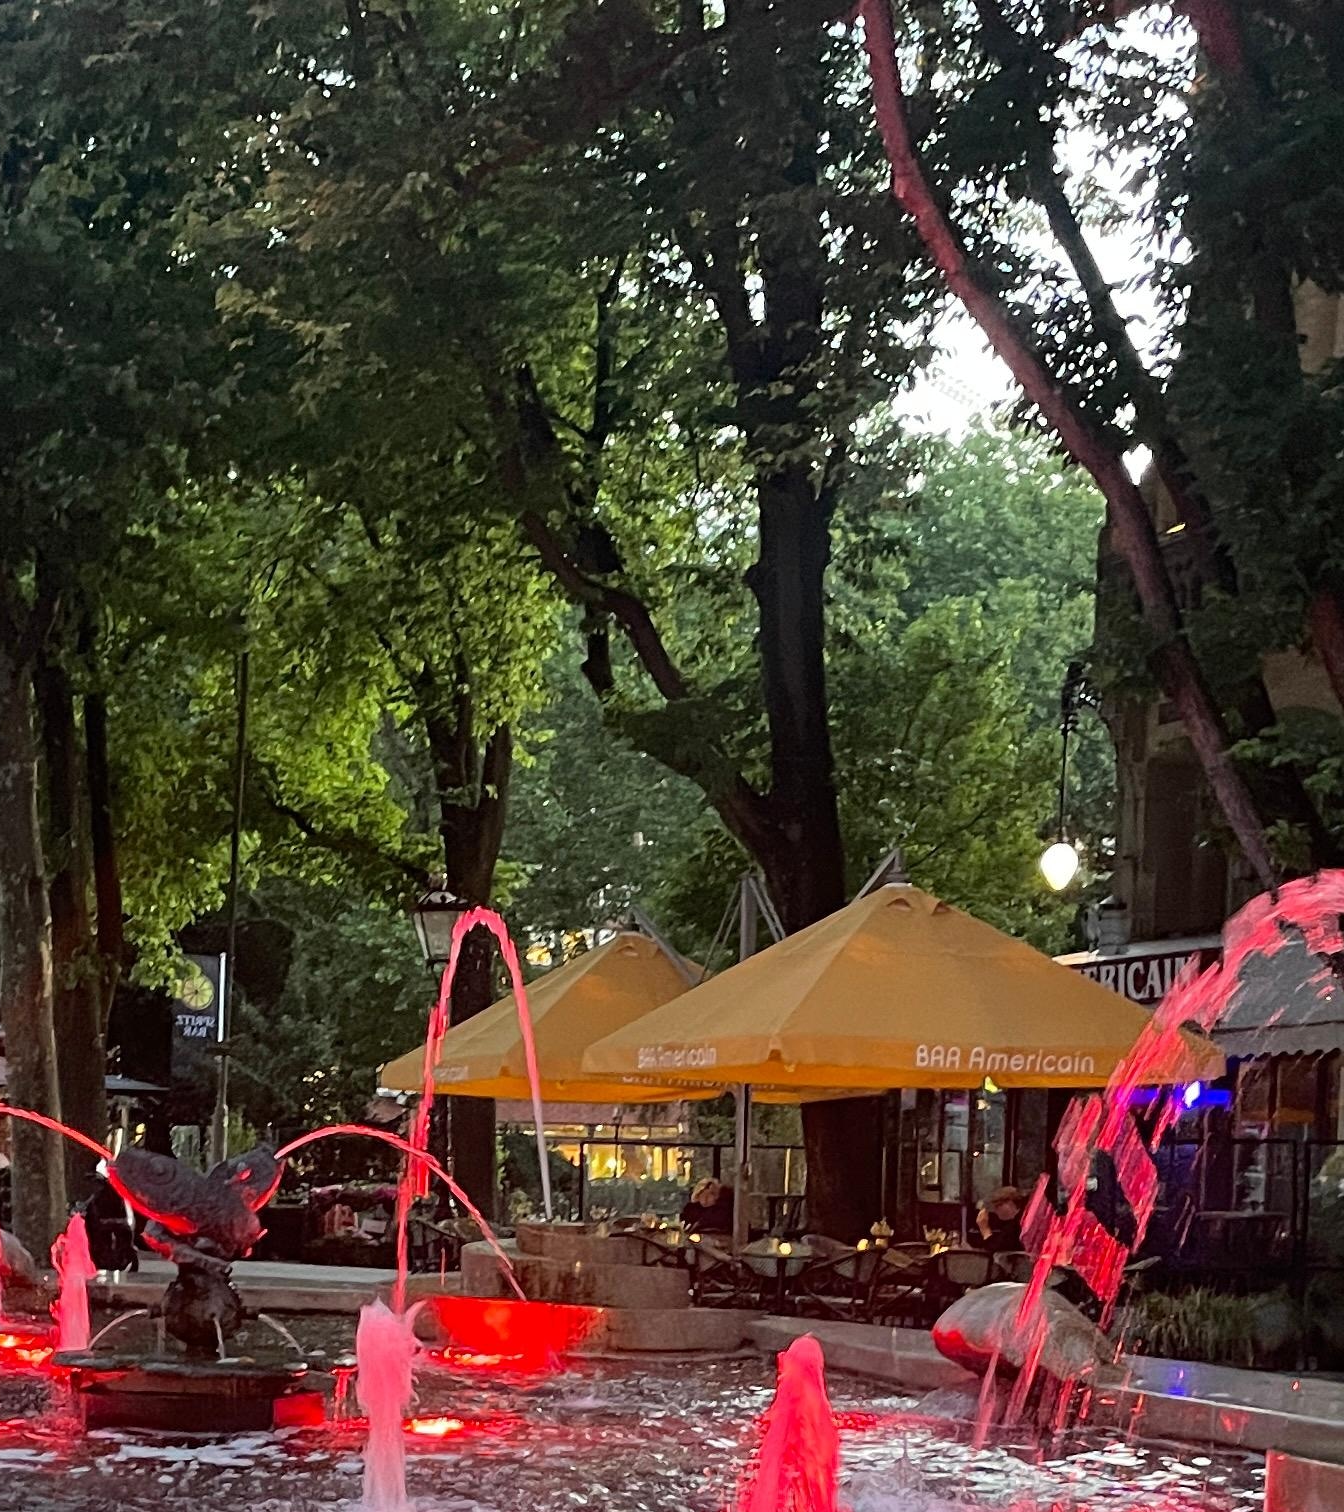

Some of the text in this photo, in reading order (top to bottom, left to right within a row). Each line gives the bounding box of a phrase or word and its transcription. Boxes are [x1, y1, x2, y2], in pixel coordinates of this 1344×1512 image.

[657, 1045, 717, 1068] Americain
[916, 1044, 1095, 1074] BAR Americain
